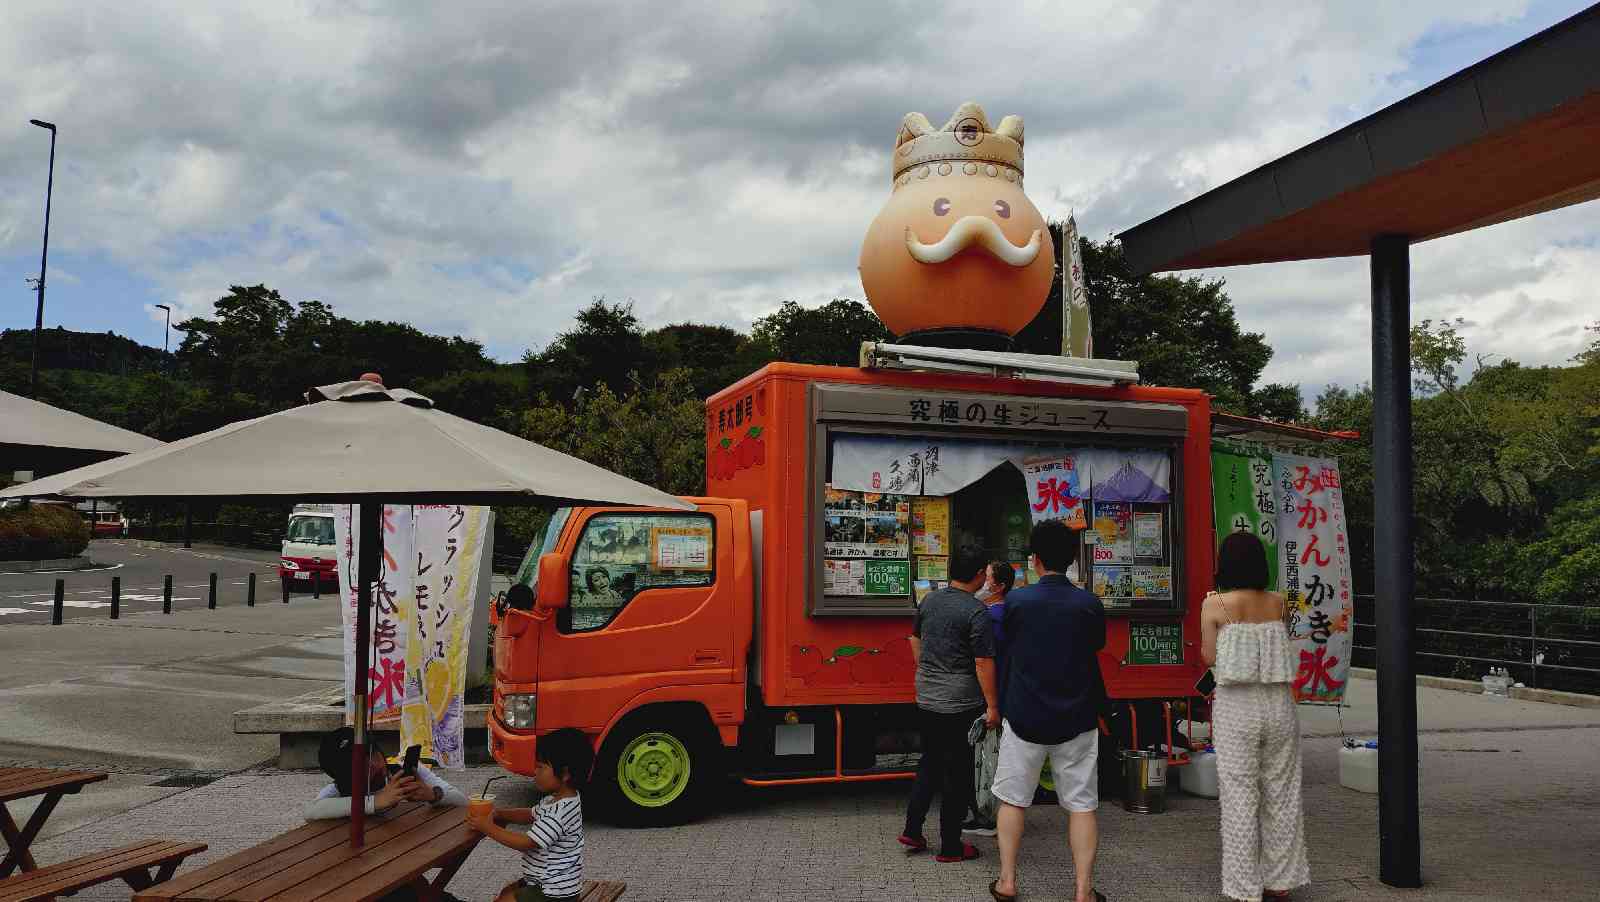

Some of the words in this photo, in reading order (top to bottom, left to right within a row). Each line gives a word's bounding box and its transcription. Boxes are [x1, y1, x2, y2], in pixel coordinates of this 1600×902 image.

[909, 399, 1111, 430] 究極の生ジュース
[1032, 477, 1081, 513] 氷
[1252, 460, 1276, 543] 究極の
[1280, 466, 1296, 514] ふわふわ
[1290, 464, 1345, 694] みかんかき氷
